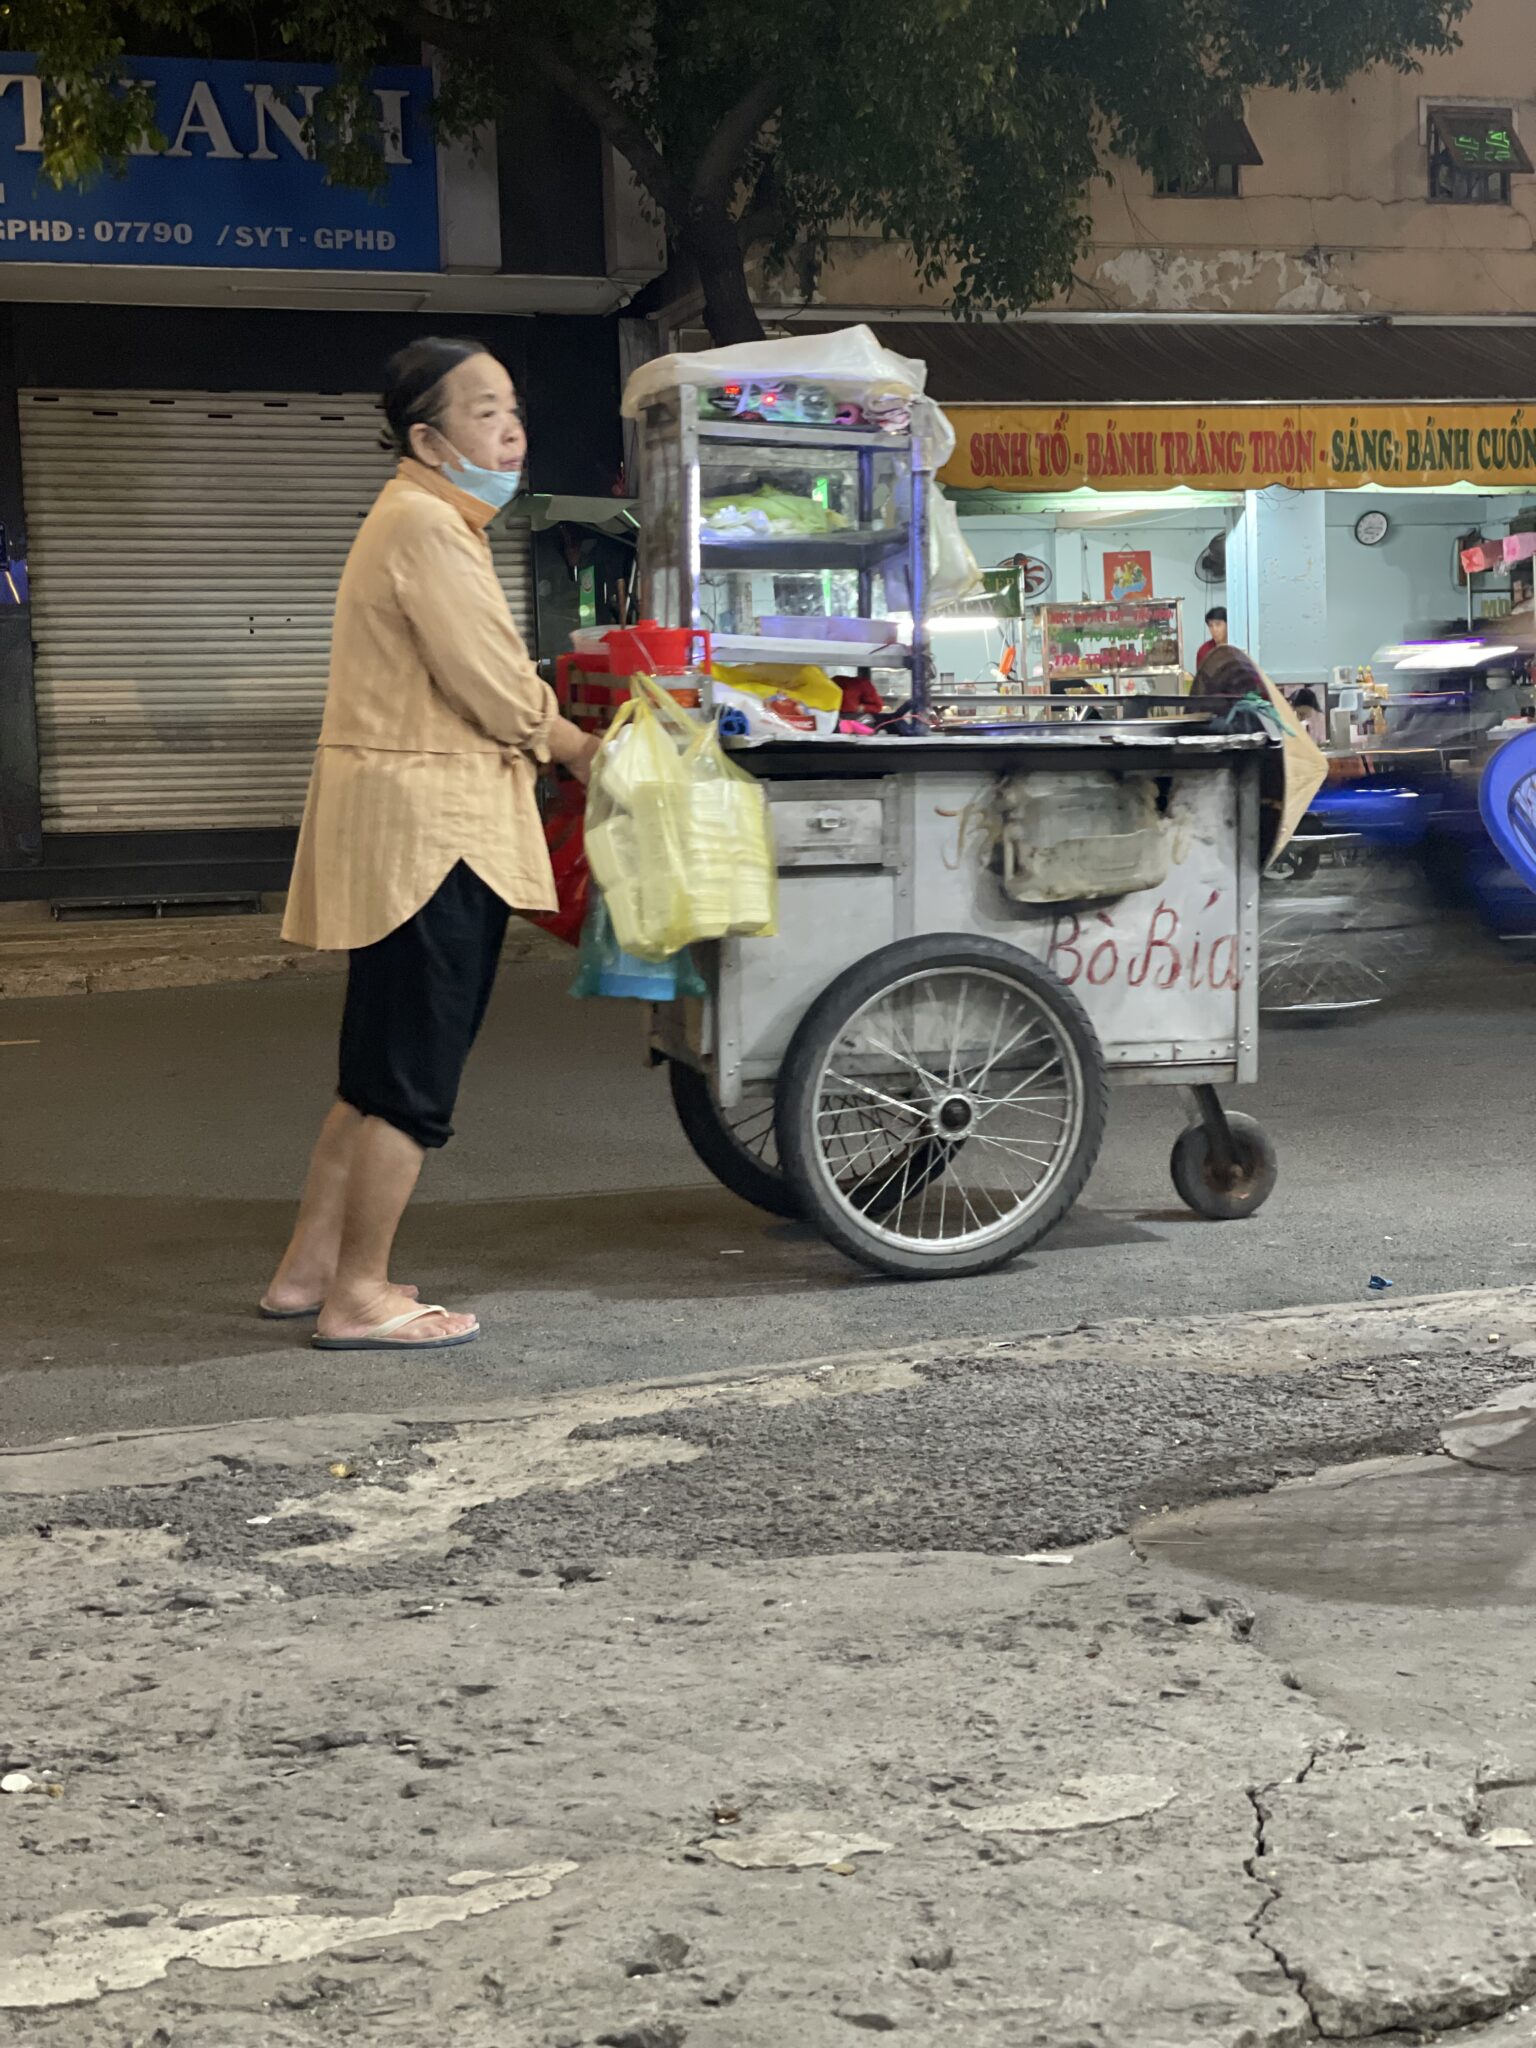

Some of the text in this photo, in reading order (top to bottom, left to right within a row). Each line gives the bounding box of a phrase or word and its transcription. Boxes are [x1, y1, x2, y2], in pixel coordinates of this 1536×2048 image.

[0, 74, 413, 164] TANH
[0, 219, 86, 242] PHĐ:
[94, 220, 193, 244] 07790
[313, 227, 396, 251] GPHĐ
[970, 431, 1031, 477] SINH
[1035, 411, 1069, 477] TỐ
[1086, 418, 1156, 477] BÁNH
[1160, 418, 1246, 477] TRÁNG
[1248, 416, 1315, 486] TRỘN
[1406, 415, 1472, 471] BÁNH
[1477, 408, 1536, 471] CUỐN
